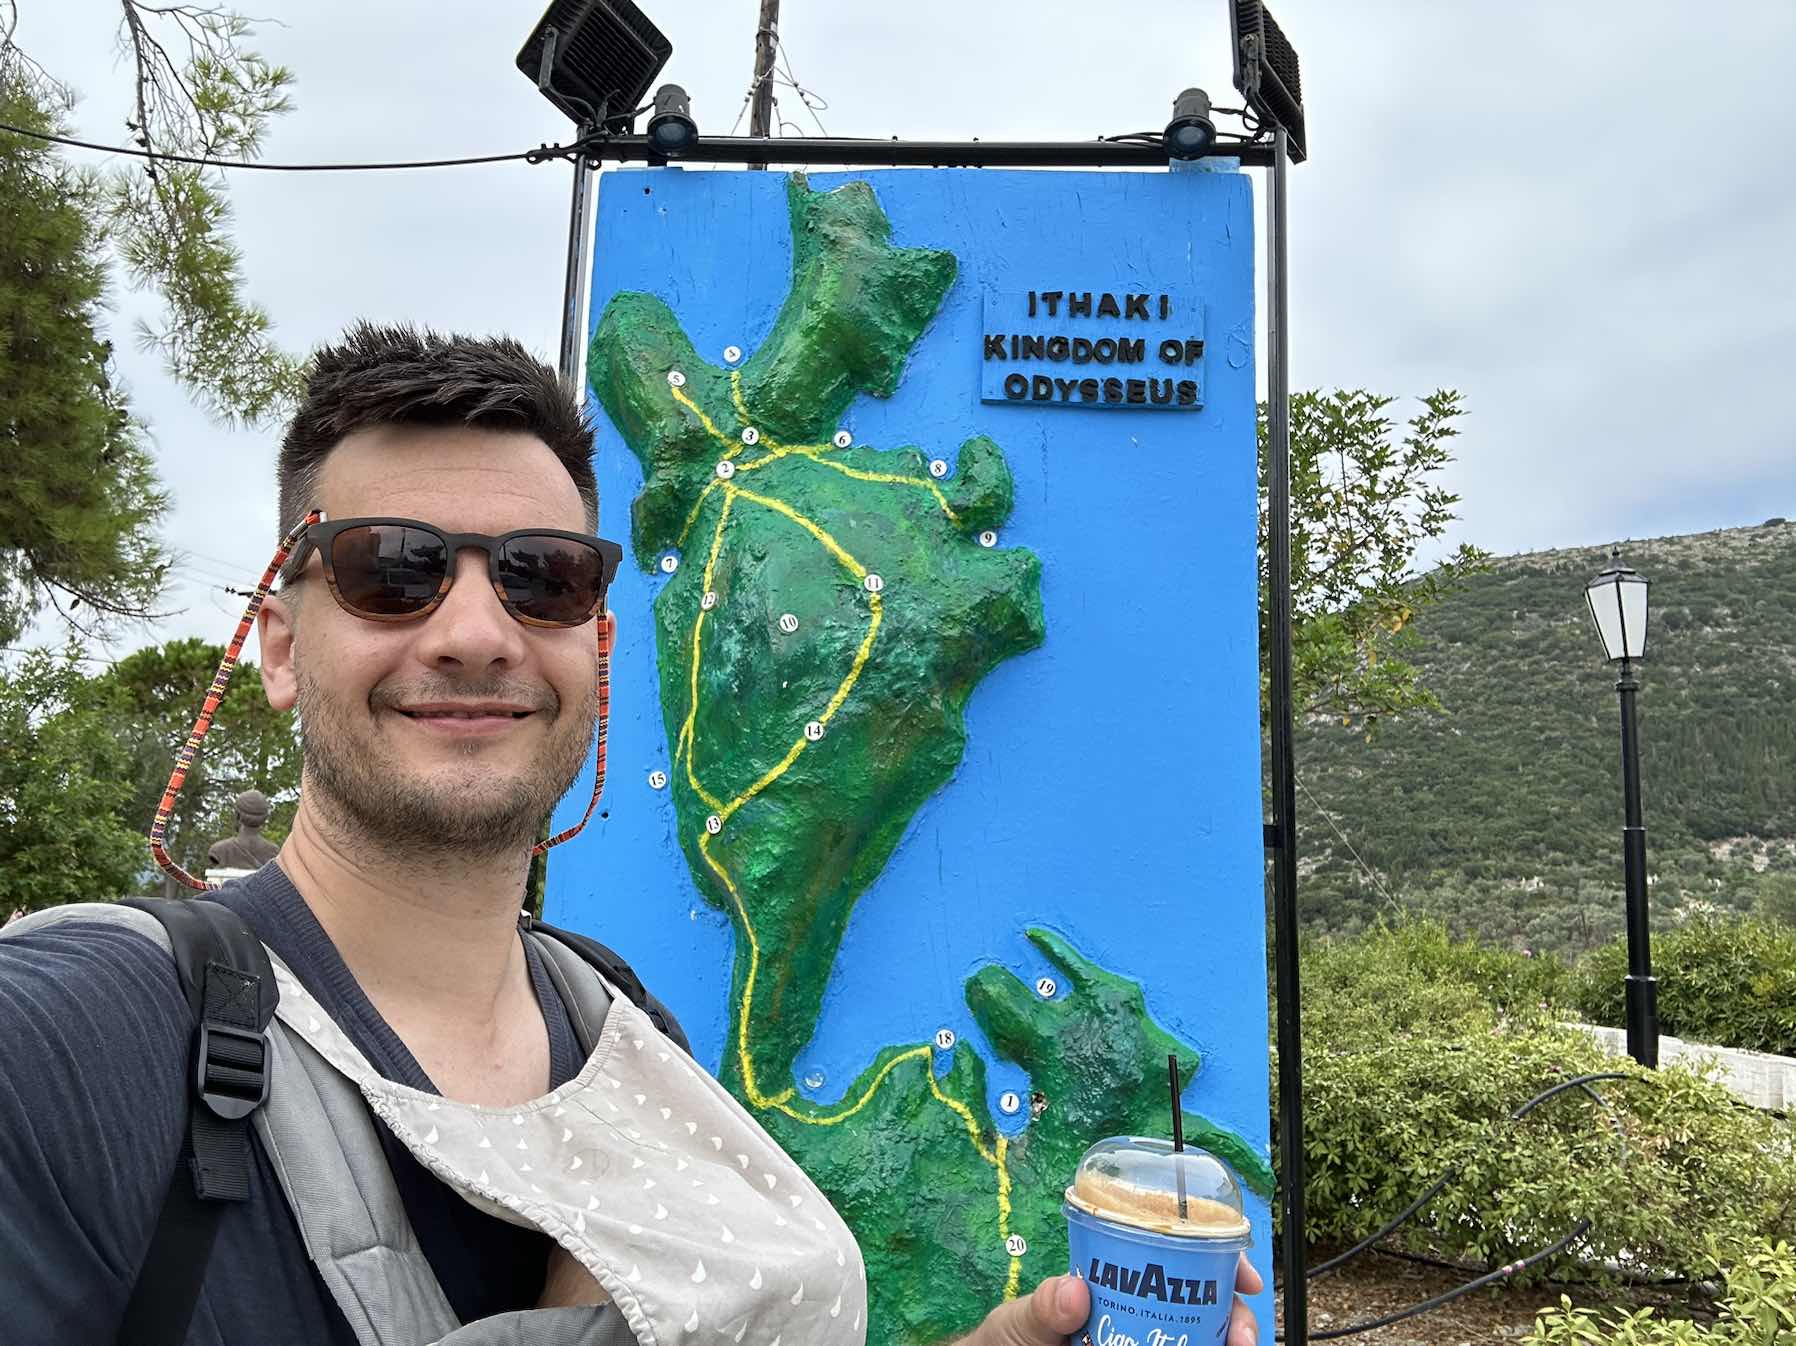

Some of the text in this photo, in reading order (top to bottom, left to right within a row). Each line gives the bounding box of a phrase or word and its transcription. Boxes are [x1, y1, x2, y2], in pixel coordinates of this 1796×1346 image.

[1028, 291, 1169, 321] ITHAKI
[983, 334, 1205, 367] KINGDOM OF
[1004, 372, 1199, 406] ODYSSEUS
[745, 430, 754, 441] 3
[984, 532, 993, 544] 9
[867, 577, 879, 589] 11
[703, 593, 714, 606] 12
[782, 617, 797, 630] 10
[807, 724, 821, 738] 14
[651, 772, 665, 787] 15
[707, 817, 720, 832] 13
[1038, 980, 1054, 995] 19
[938, 1031, 952, 1046] 18
[1009, 1237, 1025, 1253] 20
[1088, 1258, 1217, 1305] LAVAZZA
[1180, 1315, 1201, 1325] 1895
